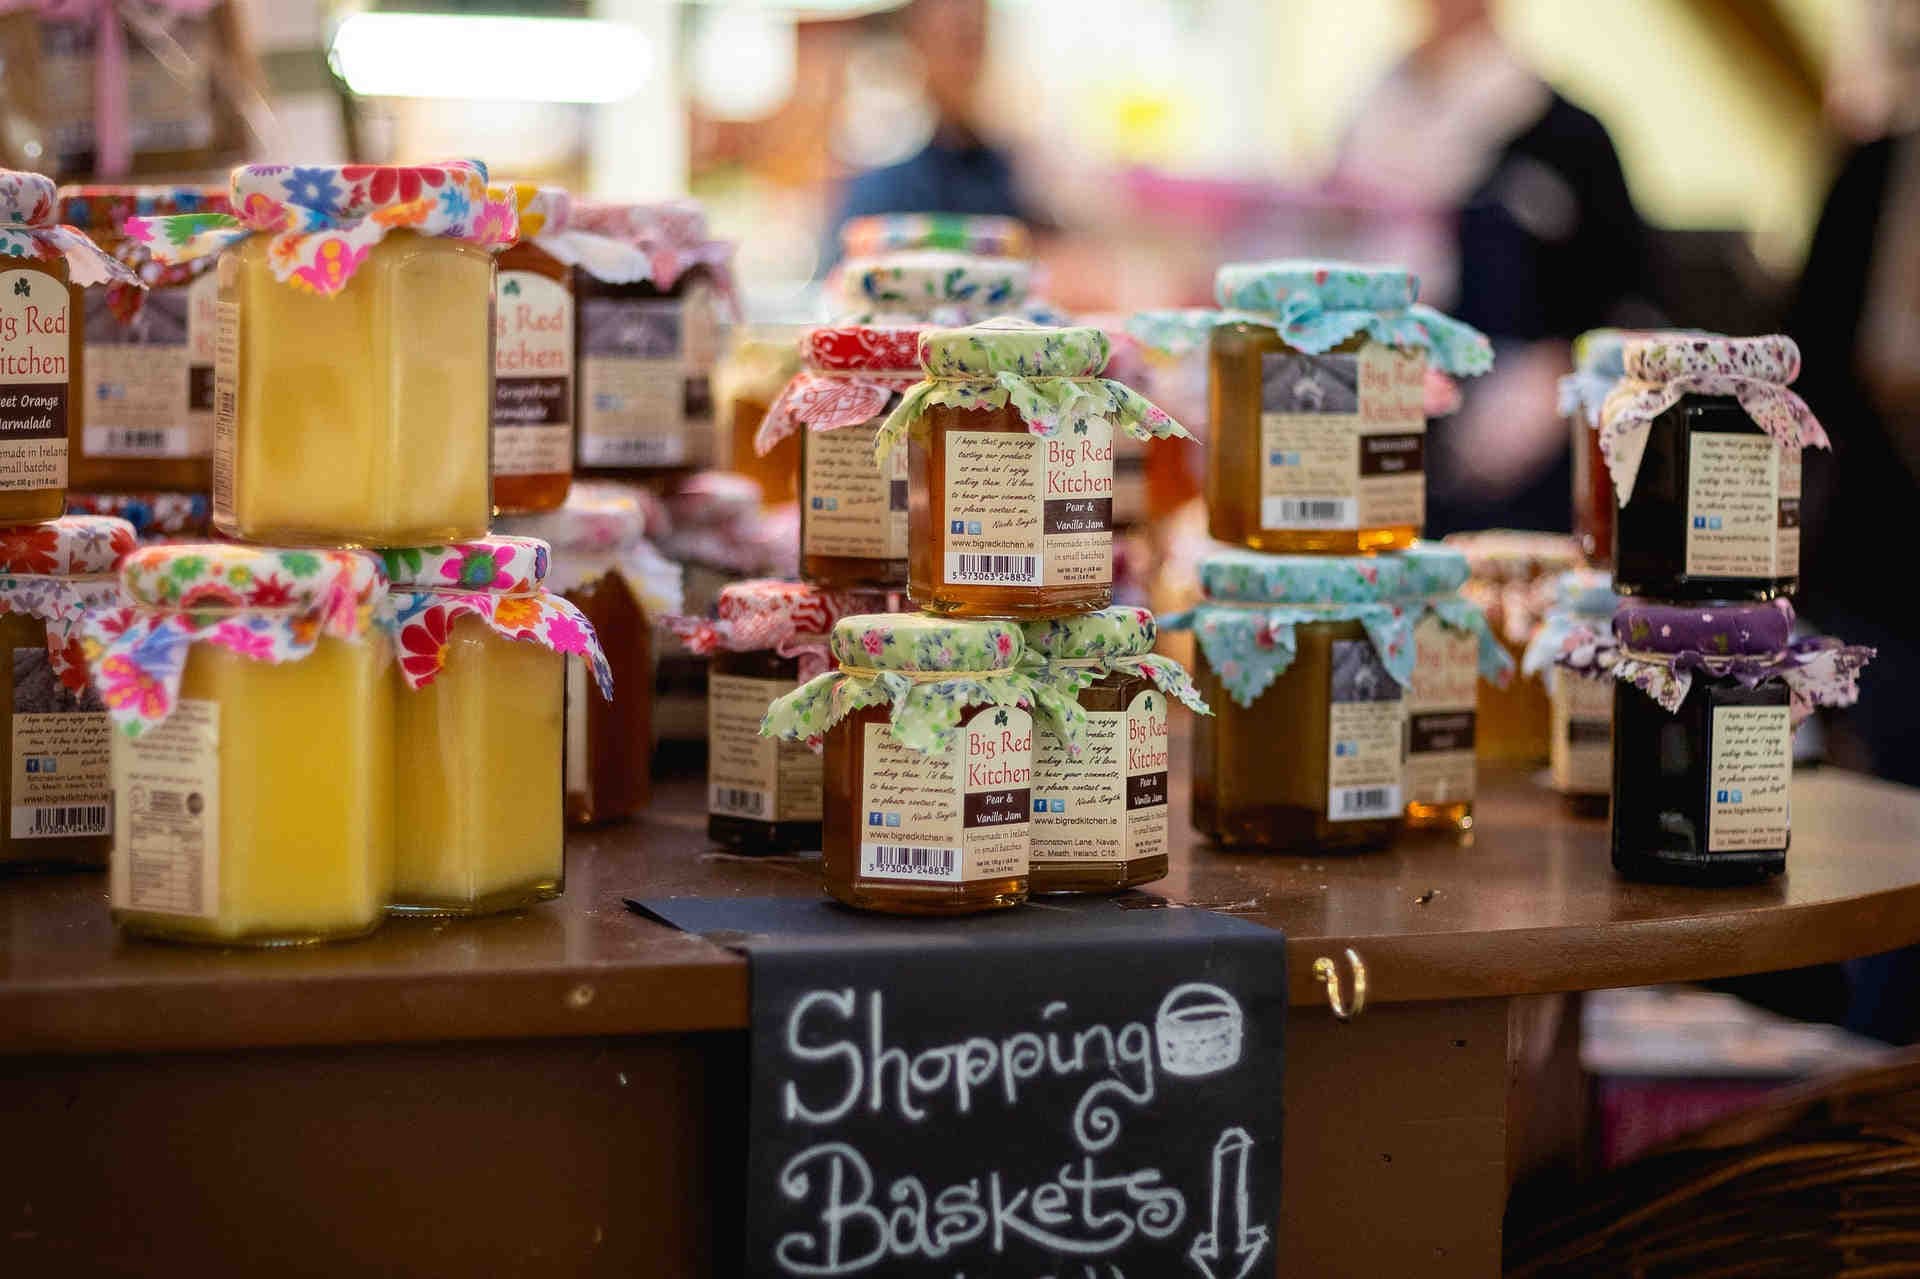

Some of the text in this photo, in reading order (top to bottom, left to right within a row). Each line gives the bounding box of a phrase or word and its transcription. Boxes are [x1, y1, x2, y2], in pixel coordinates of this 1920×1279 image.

[0, 304, 66, 342] ig Red
[0, 346, 65, 375] itchen
[496, 340, 564, 369] tchen
[0, 394, 59, 411] eet Orange
[1048, 439, 1112, 468] Big Red
[1047, 469, 1112, 494] Kitchen
[1065, 501, 1096, 513] Pear &
[1056, 519, 1105, 530] Vanilla Jam
[951, 539, 1035, 551] www.bigredkitchen.ie
[1129, 718, 1145, 745] Big
[969, 729, 1032, 760] Big Red
[1129, 745, 1168, 770] Kitchen
[968, 761, 1031, 787] Kitchen
[985, 793, 1015, 806] Pear &
[977, 811, 1022, 824] Vanilla Jam
[1034, 816, 1118, 826] www.bigredkitchen.ie
[869, 831, 954, 842] www.bigredkitchen.ie
[786, 988, 1154, 1151] Shopping
[776, 1142, 1186, 1274] Baskets
